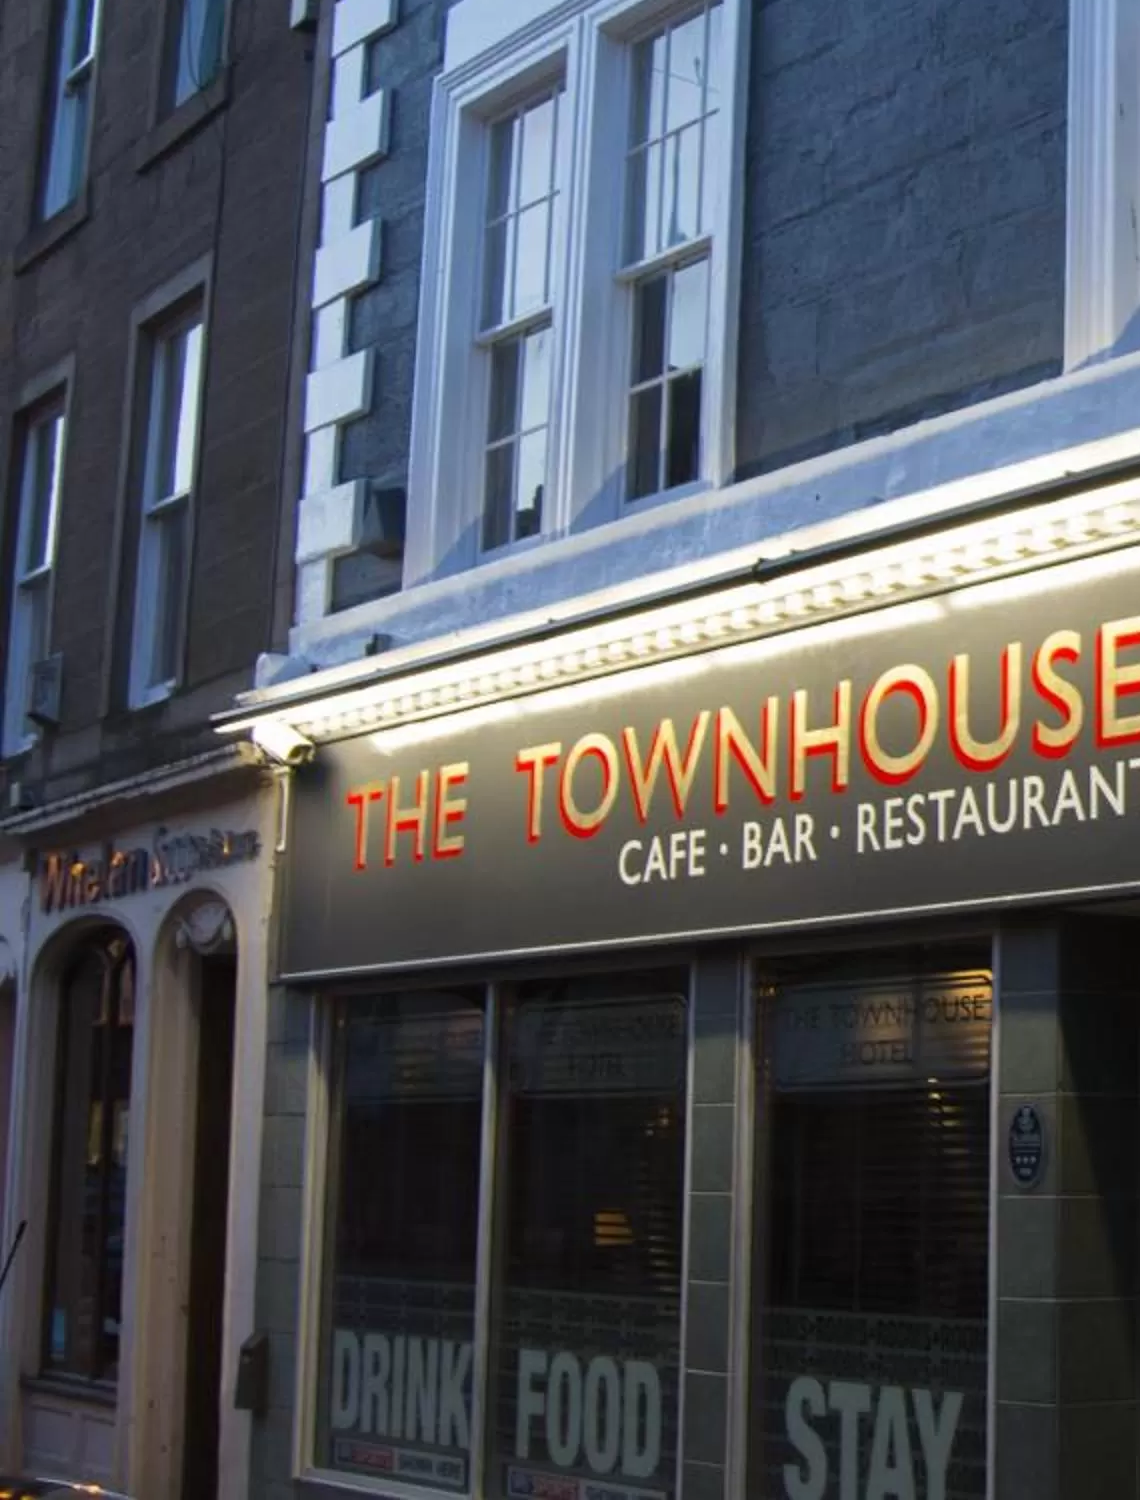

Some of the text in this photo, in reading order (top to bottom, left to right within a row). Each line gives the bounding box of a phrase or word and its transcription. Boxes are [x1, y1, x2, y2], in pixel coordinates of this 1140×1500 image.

[347, 761, 469, 871] THE
[618, 828, 706, 885] CAFE
[742, 813, 818, 870] BAR
[331, 1329, 475, 1449] DRINK
[515, 1347, 662, 1478] FOOD
[783, 1376, 965, 1500] STAY
